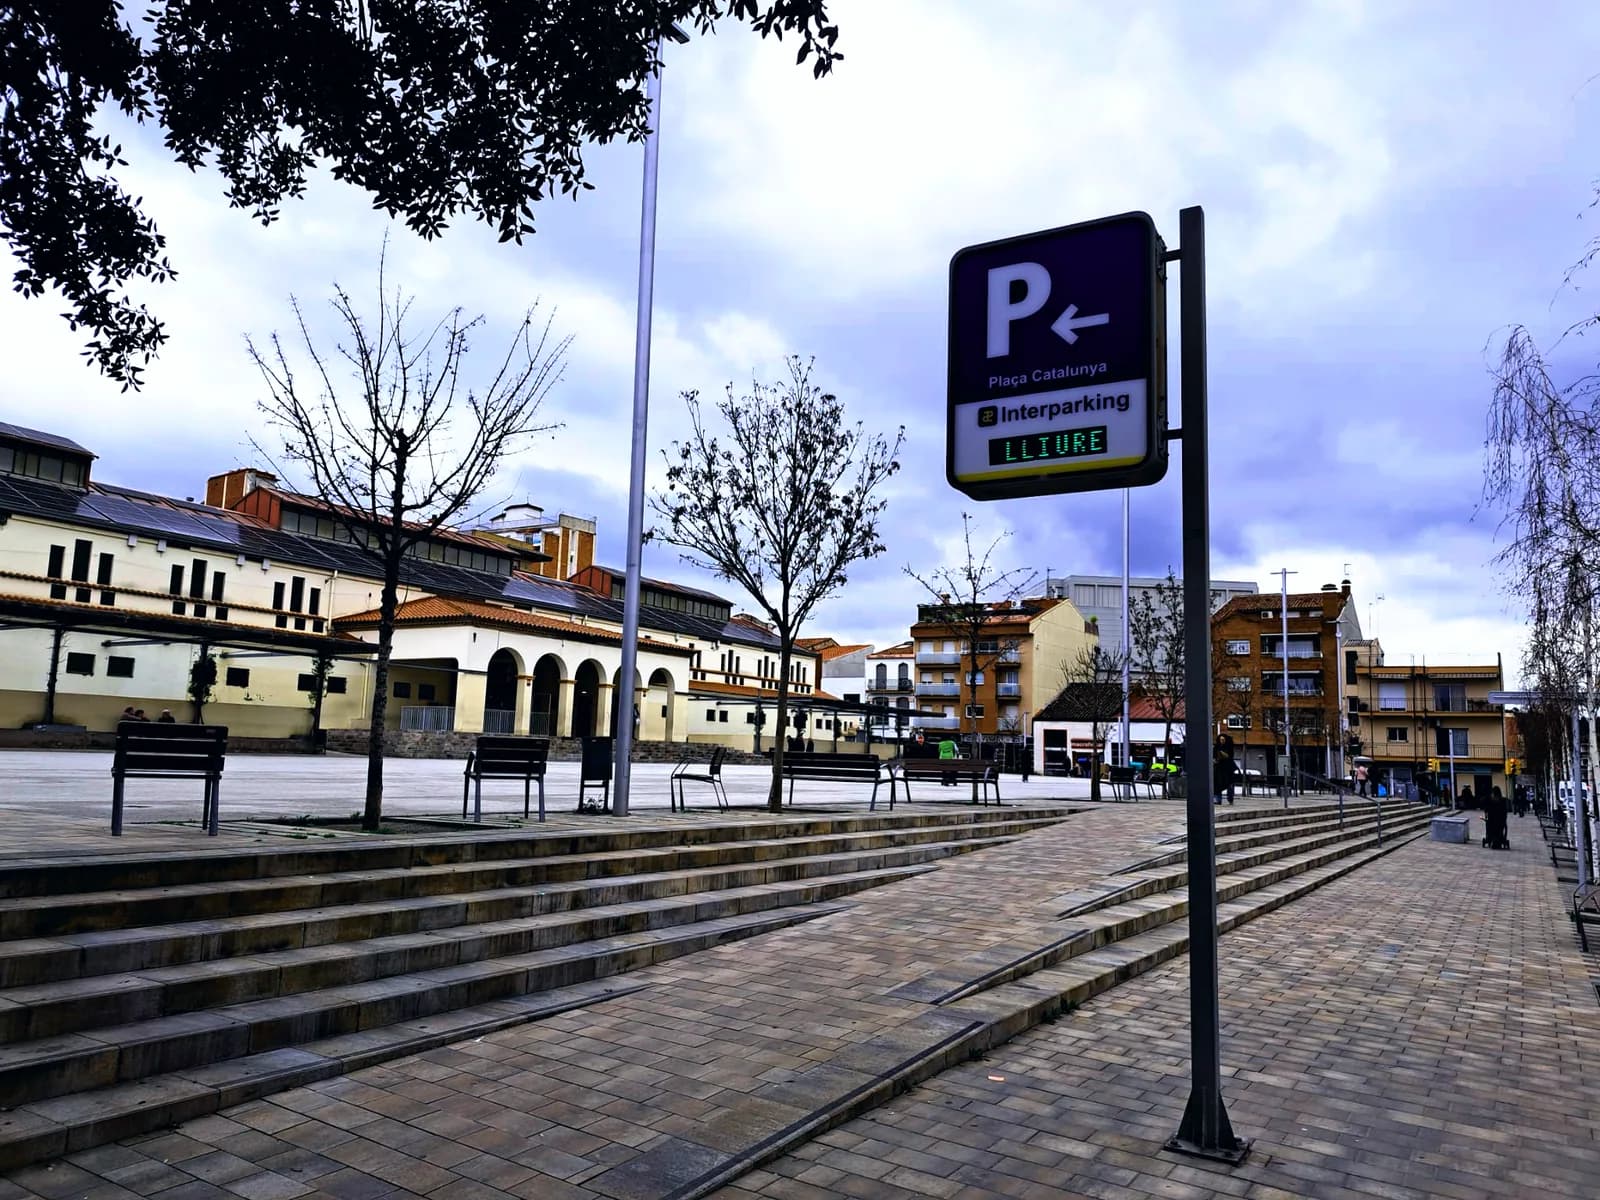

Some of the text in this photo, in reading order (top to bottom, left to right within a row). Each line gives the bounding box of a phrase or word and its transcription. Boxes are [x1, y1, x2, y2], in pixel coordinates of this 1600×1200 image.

[986, 262, 1051, 358] P
[989, 362, 1108, 389] Plaça Catalunya
[1002, 394, 1130, 421] Interparking
[1006, 430, 1103, 461] LLIURE
